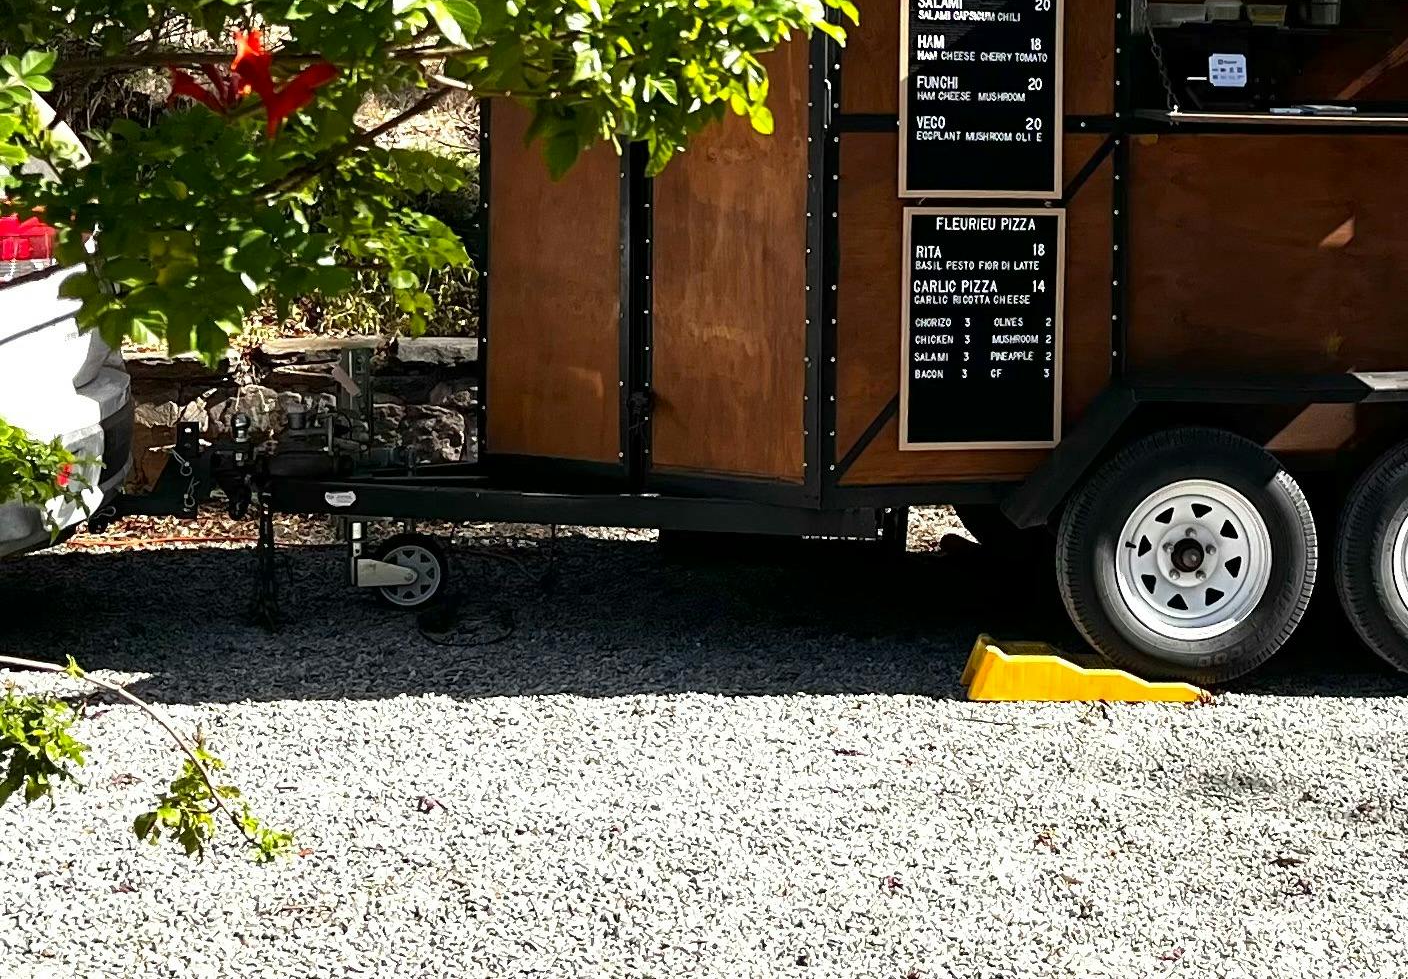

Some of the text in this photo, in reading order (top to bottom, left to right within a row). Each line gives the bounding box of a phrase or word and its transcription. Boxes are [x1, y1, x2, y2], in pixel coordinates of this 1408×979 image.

[918, 10, 950, 20] SALAMI
[998, 12, 1020, 22] CHILI
[918, 35, 1041, 51] HAM 18
[917, 50, 1048, 63] HAM CHEESE CHERRY TOMATO
[916, 75, 1042, 91] FUNGHI 20
[917, 91, 1025, 102] HAM CHEESE MUSHROOM
[1025, 118, 1042, 130] 20
[916, 131, 961, 140] EGGPLANT
[965, 132, 1012, 141] MUSHROOM
[936, 217, 1036, 231] FLEURIEU PIZZA
[916, 243, 1045, 259] RITA 18
[915, 261, 1040, 270] BASIL PESTO FIOR DI LATTE
[913, 280, 1045, 293] GARLIC PIZZA 14
[914, 295, 1030, 305] GARLIC RICOTTA CHEESE
[915, 318, 971, 327] CHORIZO 3
[994, 318, 1051, 327] OLIVES 2
[915, 335, 971, 345] CHICKEN 3
[992, 335, 1051, 344] MUSHROOM 2
[914, 352, 970, 362] SALAMI 3
[990, 351, 1051, 361] PINEAPPLE 2
[915, 369, 968, 379] BACON 3
[1044, 369, 1050, 378] 3
